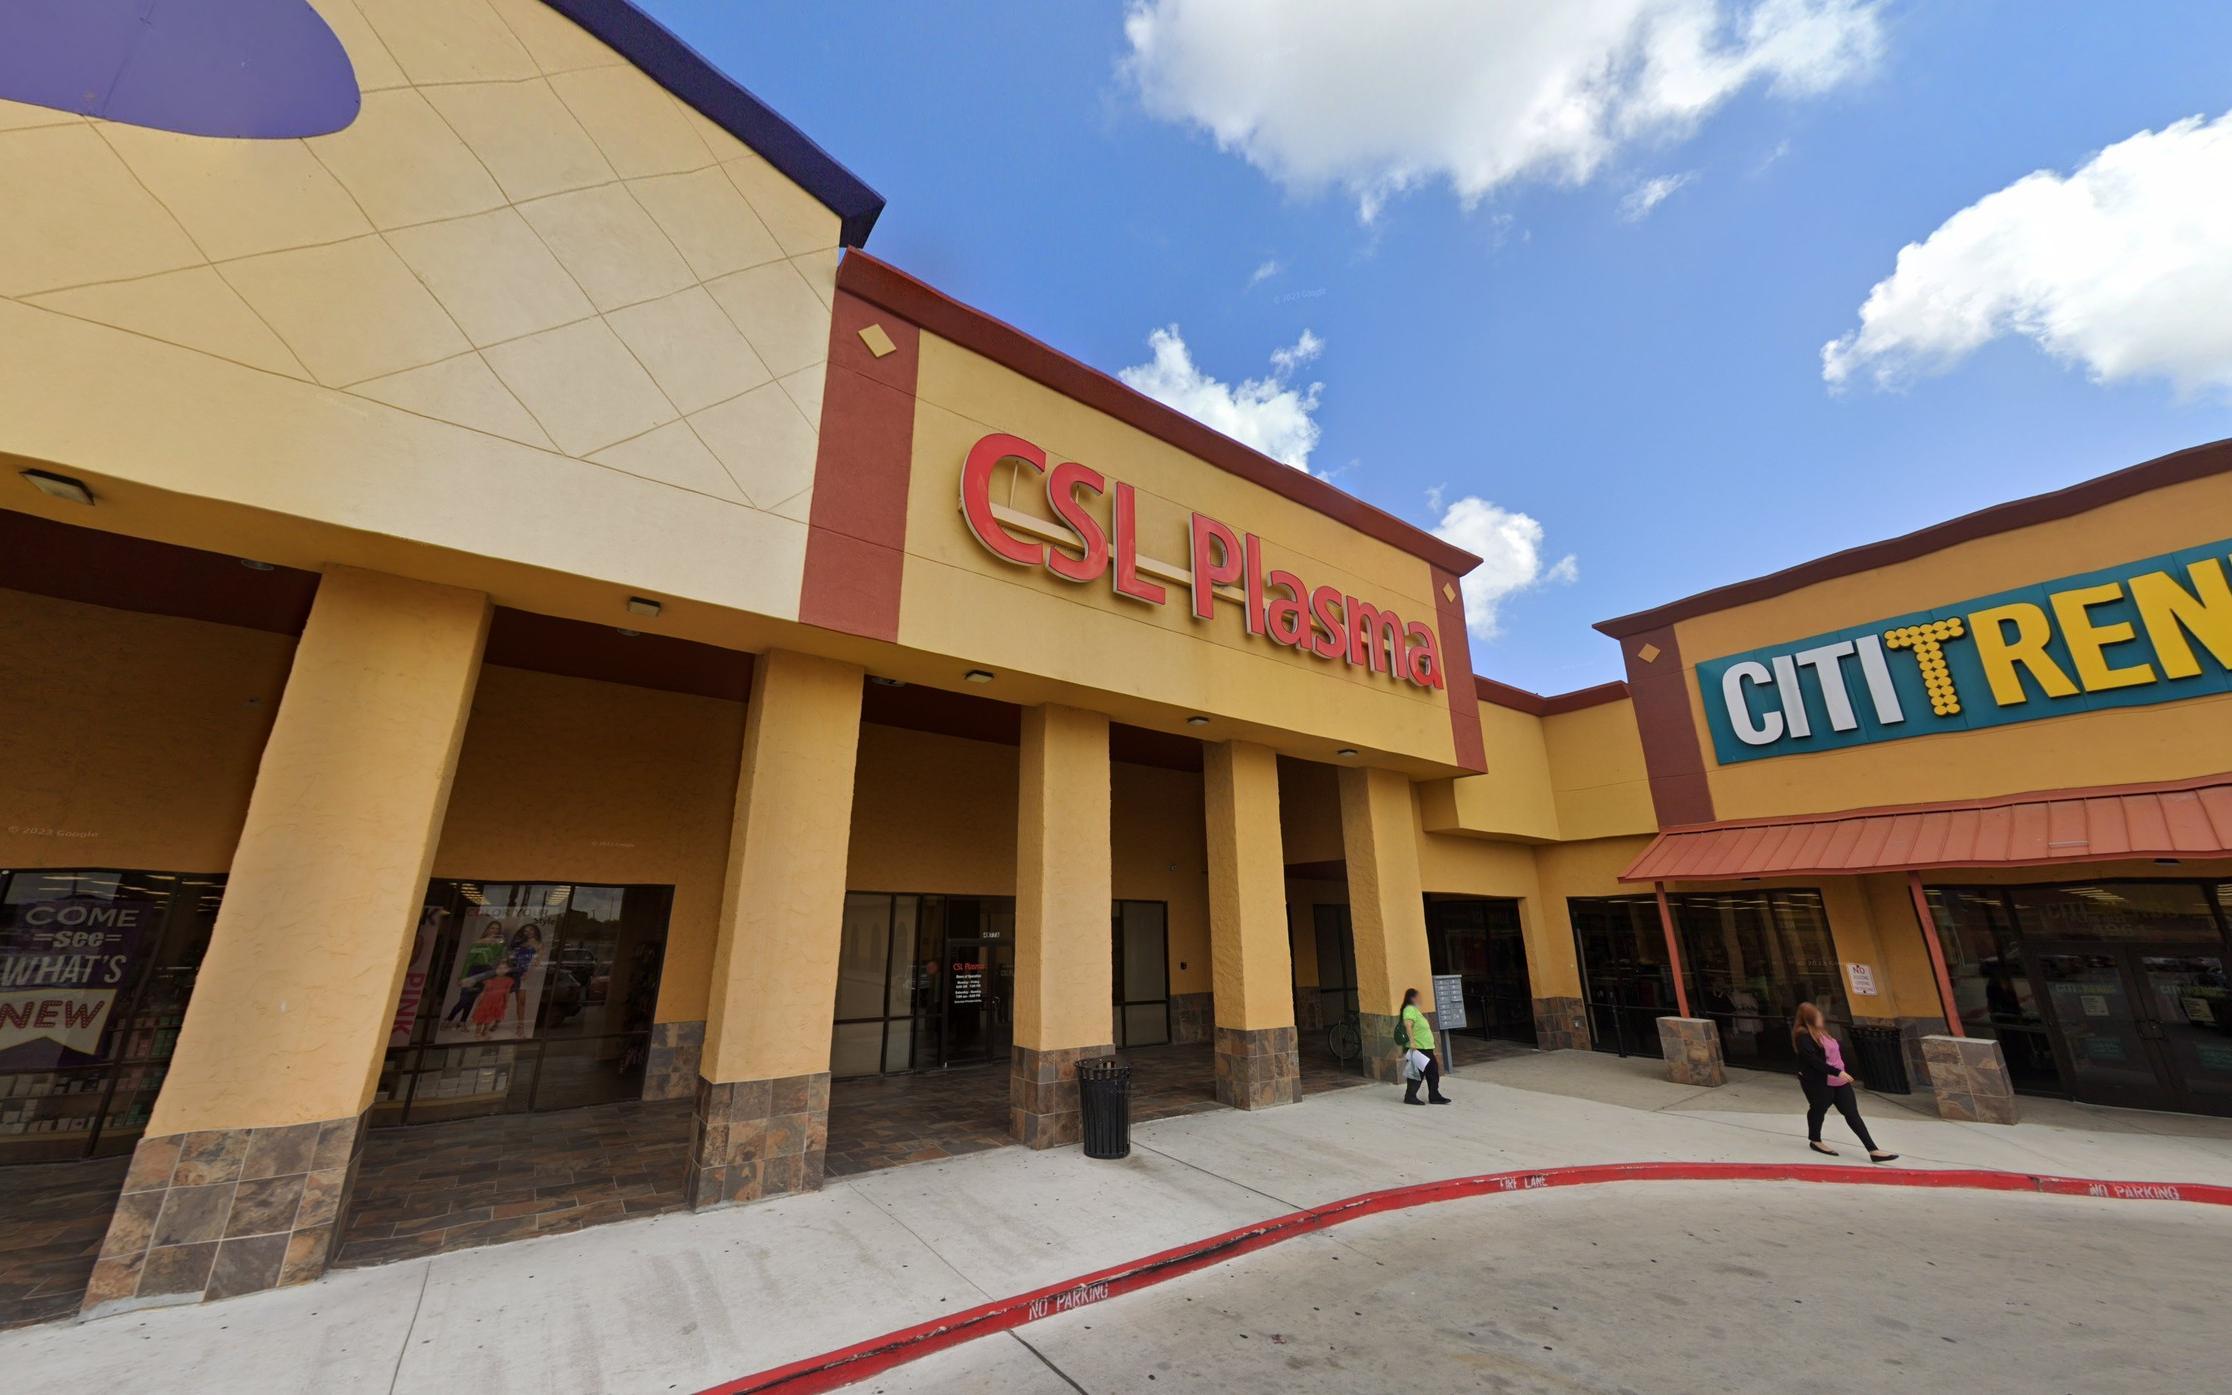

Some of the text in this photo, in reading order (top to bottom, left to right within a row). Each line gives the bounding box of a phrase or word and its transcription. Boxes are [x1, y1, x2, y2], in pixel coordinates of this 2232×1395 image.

[960, 433, 1444, 690] CSL Plasma
[24, 905, 140, 928] COME
[52, 930, 105, 948] see
[0, 954, 128, 987] WHAT'S
[0, 1000, 105, 1030] NEW
[393, 972, 425, 1036] PINK
[2089, 1184, 2180, 1200] NO PARKING
[1028, 1283, 1109, 1321] NO PARKING
